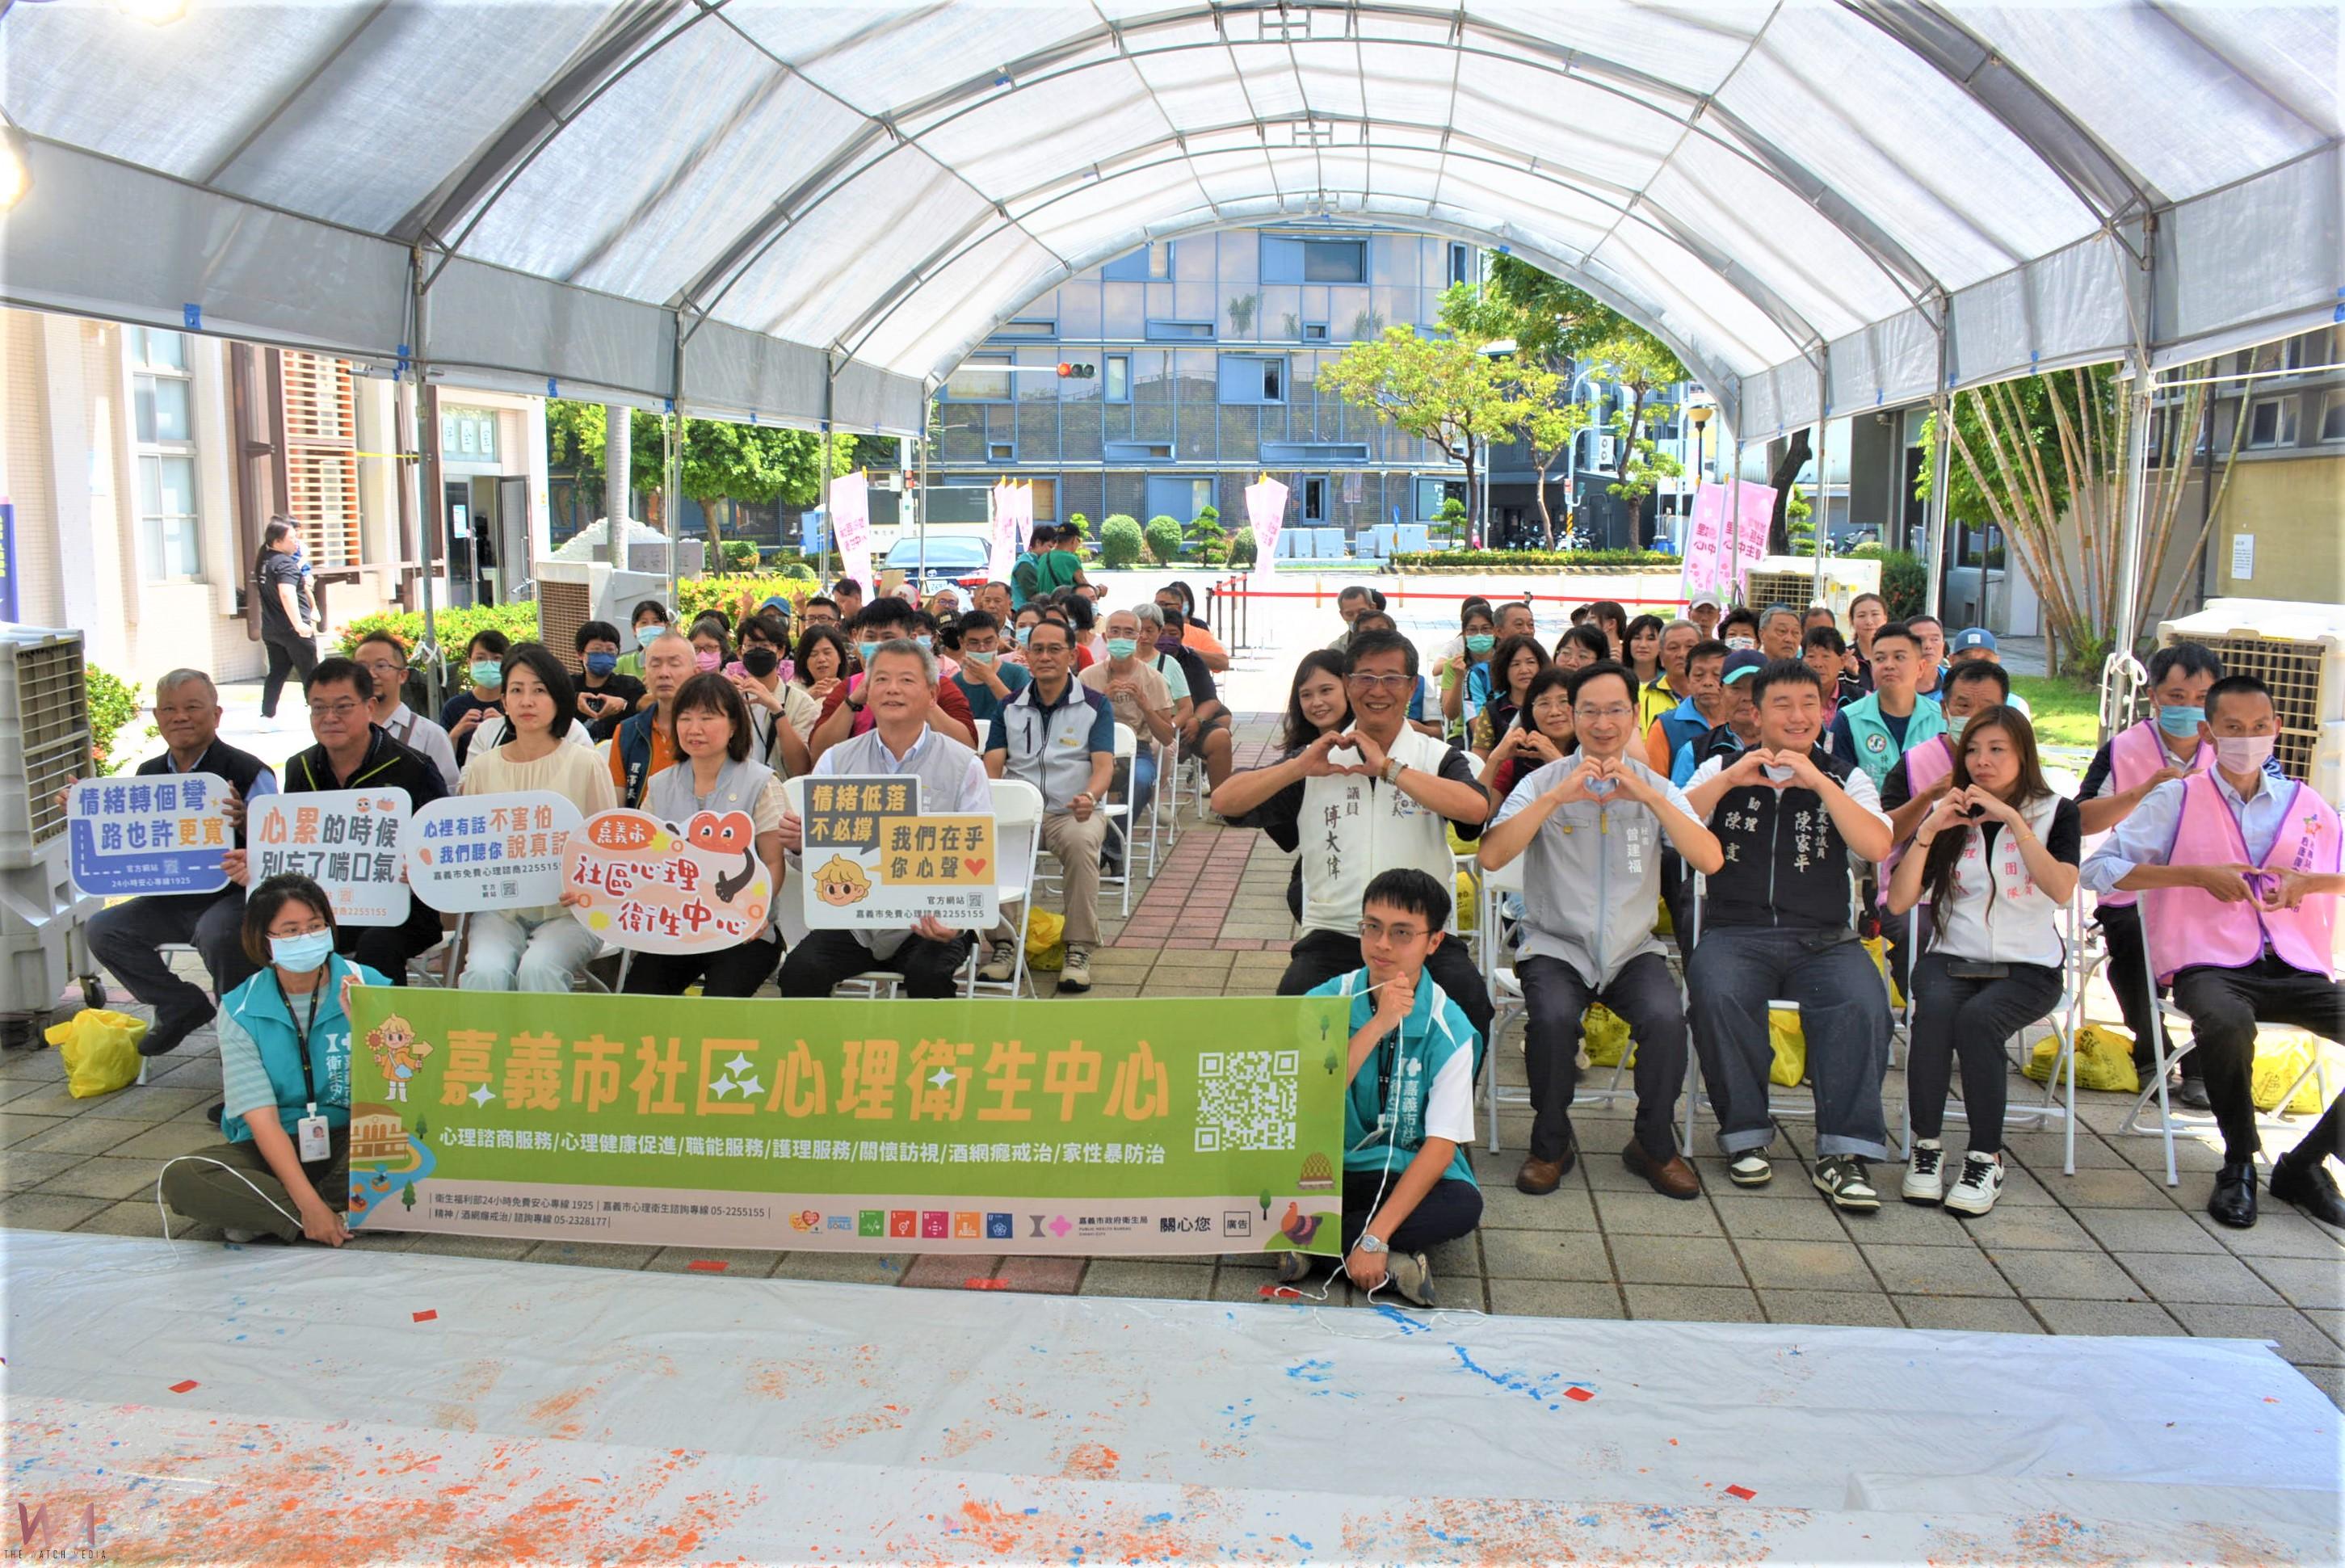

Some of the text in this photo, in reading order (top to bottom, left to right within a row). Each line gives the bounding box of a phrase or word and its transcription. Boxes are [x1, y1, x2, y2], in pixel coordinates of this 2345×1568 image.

[78, 780, 207, 815] 情緒轉個彎
[813, 784, 906, 812] 情緒低落
[1347, 787, 1360, 816] 議員
[258, 806, 399, 848] 心累的時候
[424, 805, 553, 838] 心裡有話不害怕
[1744, 797, 1762, 832] 助理
[101, 817, 224, 850] 路也許更寬
[597, 821, 645, 844] 嘉義市
[810, 818, 872, 841] 不必撐
[891, 826, 984, 851] 我們在乎
[1324, 805, 1341, 881] 傅大偉
[1793, 810, 1812, 873] 陳家平
[439, 830, 570, 864] 我們聽你說真話
[1626, 827, 1641, 873] 曾建福
[126, 864, 158, 873] 官方網站
[260, 851, 396, 883] 別忘了喘口氣
[574, 855, 700, 896] 社區心理
[890, 856, 958, 878] 你心聲
[111, 876, 191, 888] 24小時安心專線1925
[927, 896, 964, 905] 官方網站
[618, 898, 746, 936] 衛生中心
[554, 1216, 607, 1226] 05-2328177
[572, 1200, 594, 1209] 1925
[711, 1208, 764, 1217] 05-2255155
[1079, 1216, 1148, 1225] 嘉義市政府衛生局
[1160, 1217, 1211, 1233] 關心您
[1226, 1220, 1247, 1229] 廣告
